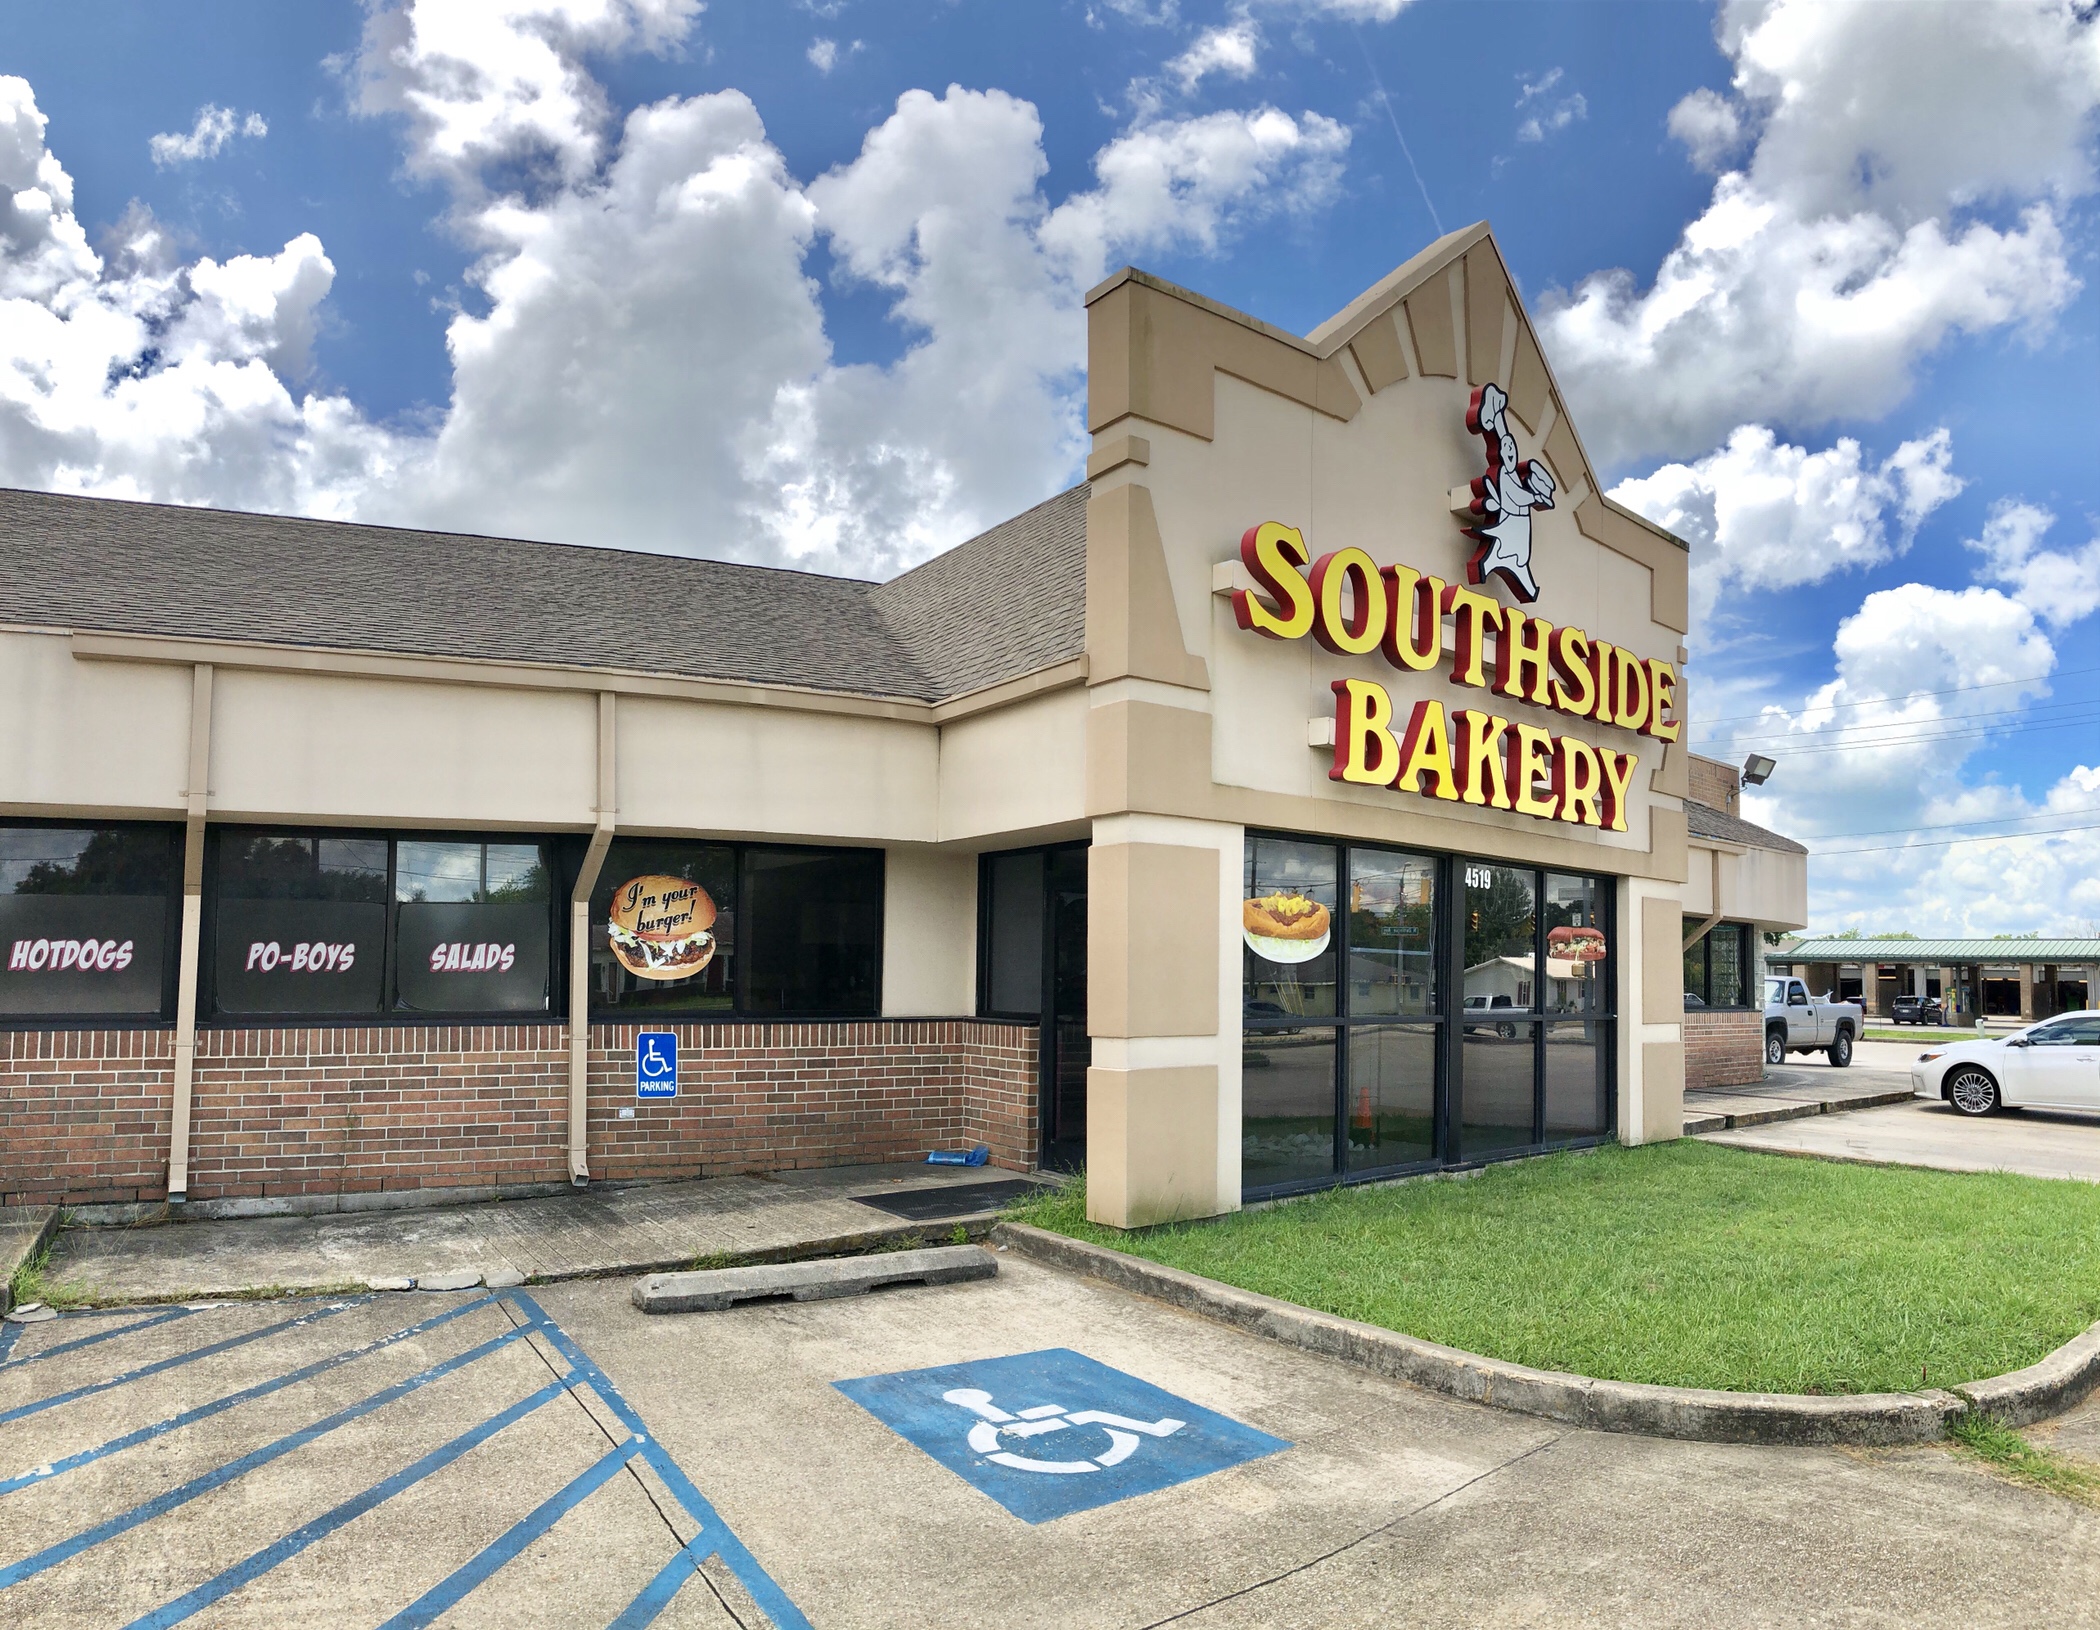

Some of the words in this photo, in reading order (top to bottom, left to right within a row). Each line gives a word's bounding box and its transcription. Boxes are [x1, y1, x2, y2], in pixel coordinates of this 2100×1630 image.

[1232, 521, 1681, 743] SOUTHSIDE
[1329, 679, 1639, 832] BAKERY
[1465, 867, 1491, 890] 4519
[622, 882, 656, 912] I'm
[662, 885, 699, 912] your
[636, 899, 697, 936] burger!
[8, 938, 133, 972] HOTDOGS
[245, 941, 355, 973] PO-BOYS
[429, 942, 515, 973] SALADS
[640, 1080, 675, 1092] PARKING
